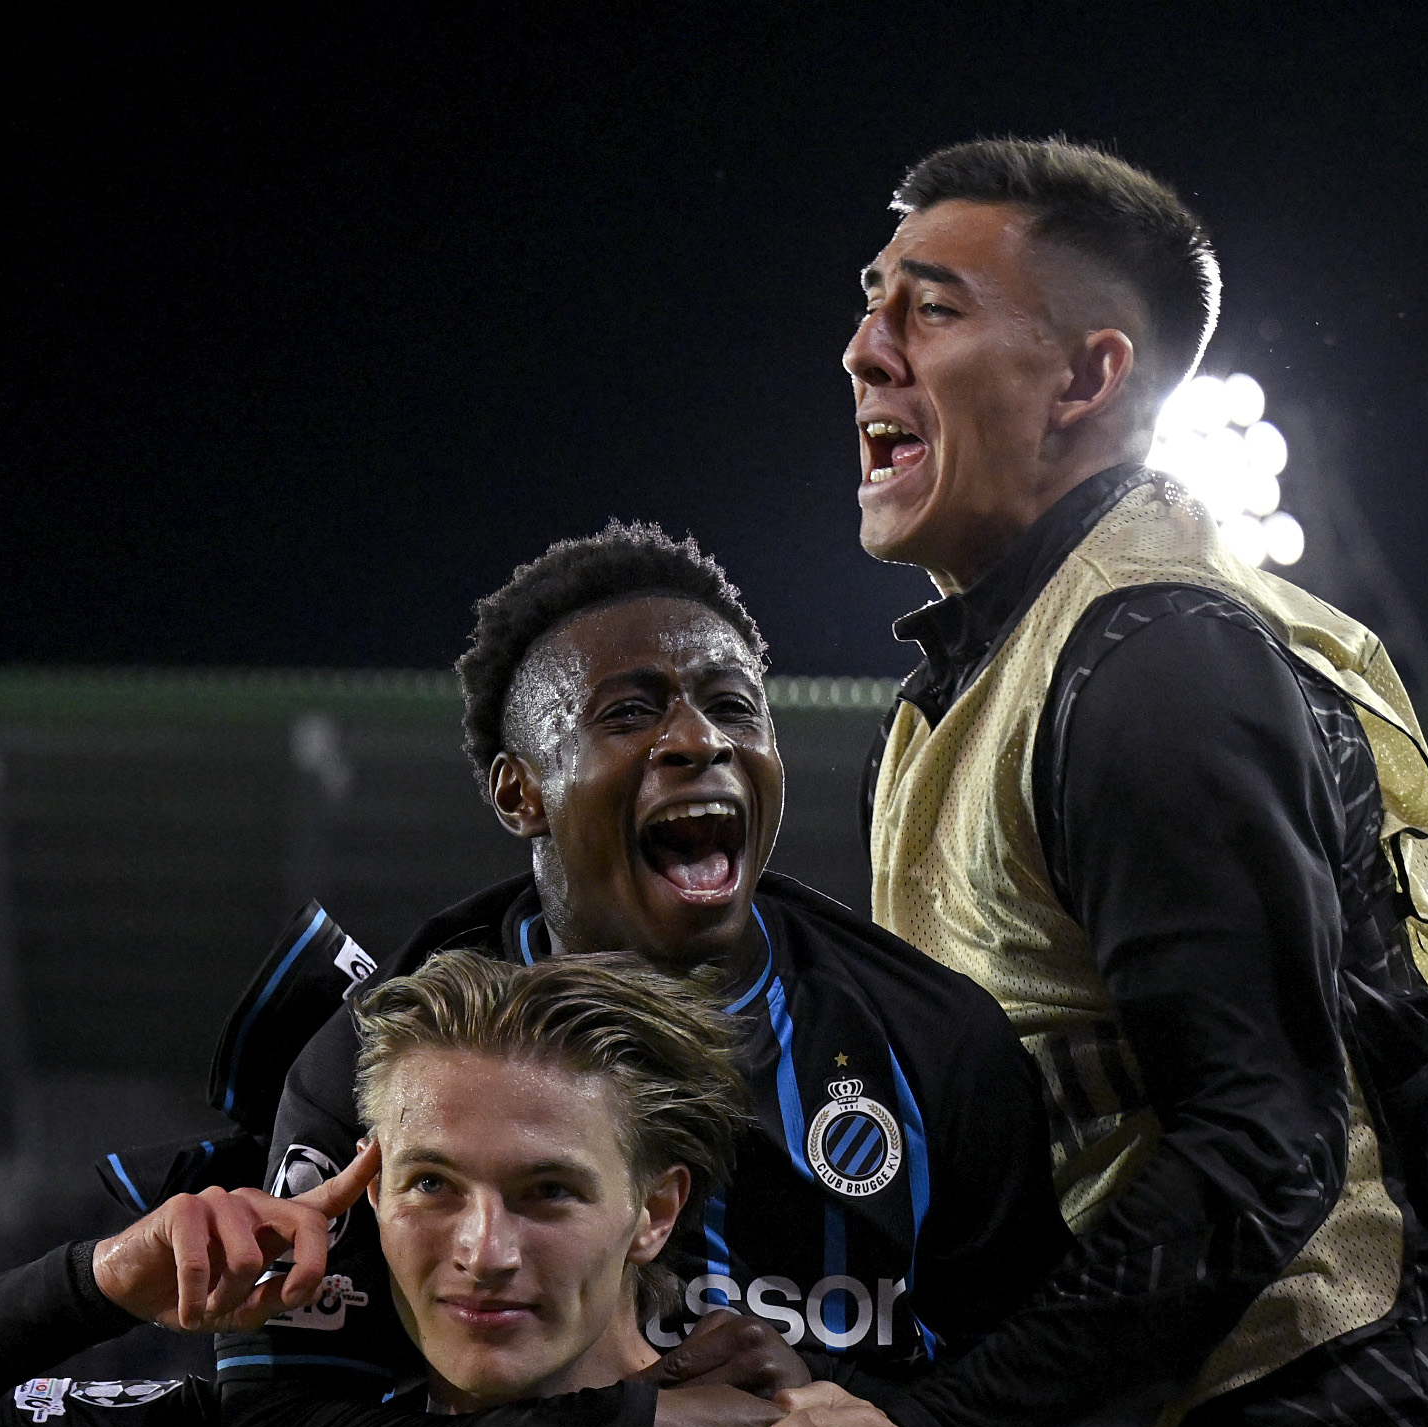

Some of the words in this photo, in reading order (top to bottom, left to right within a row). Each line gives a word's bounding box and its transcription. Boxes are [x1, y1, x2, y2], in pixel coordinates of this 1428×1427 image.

[816, 1162, 844, 1189] CLUB
[846, 1170, 891, 1195] BRUGGE
[886, 1152, 900, 1171] KV
